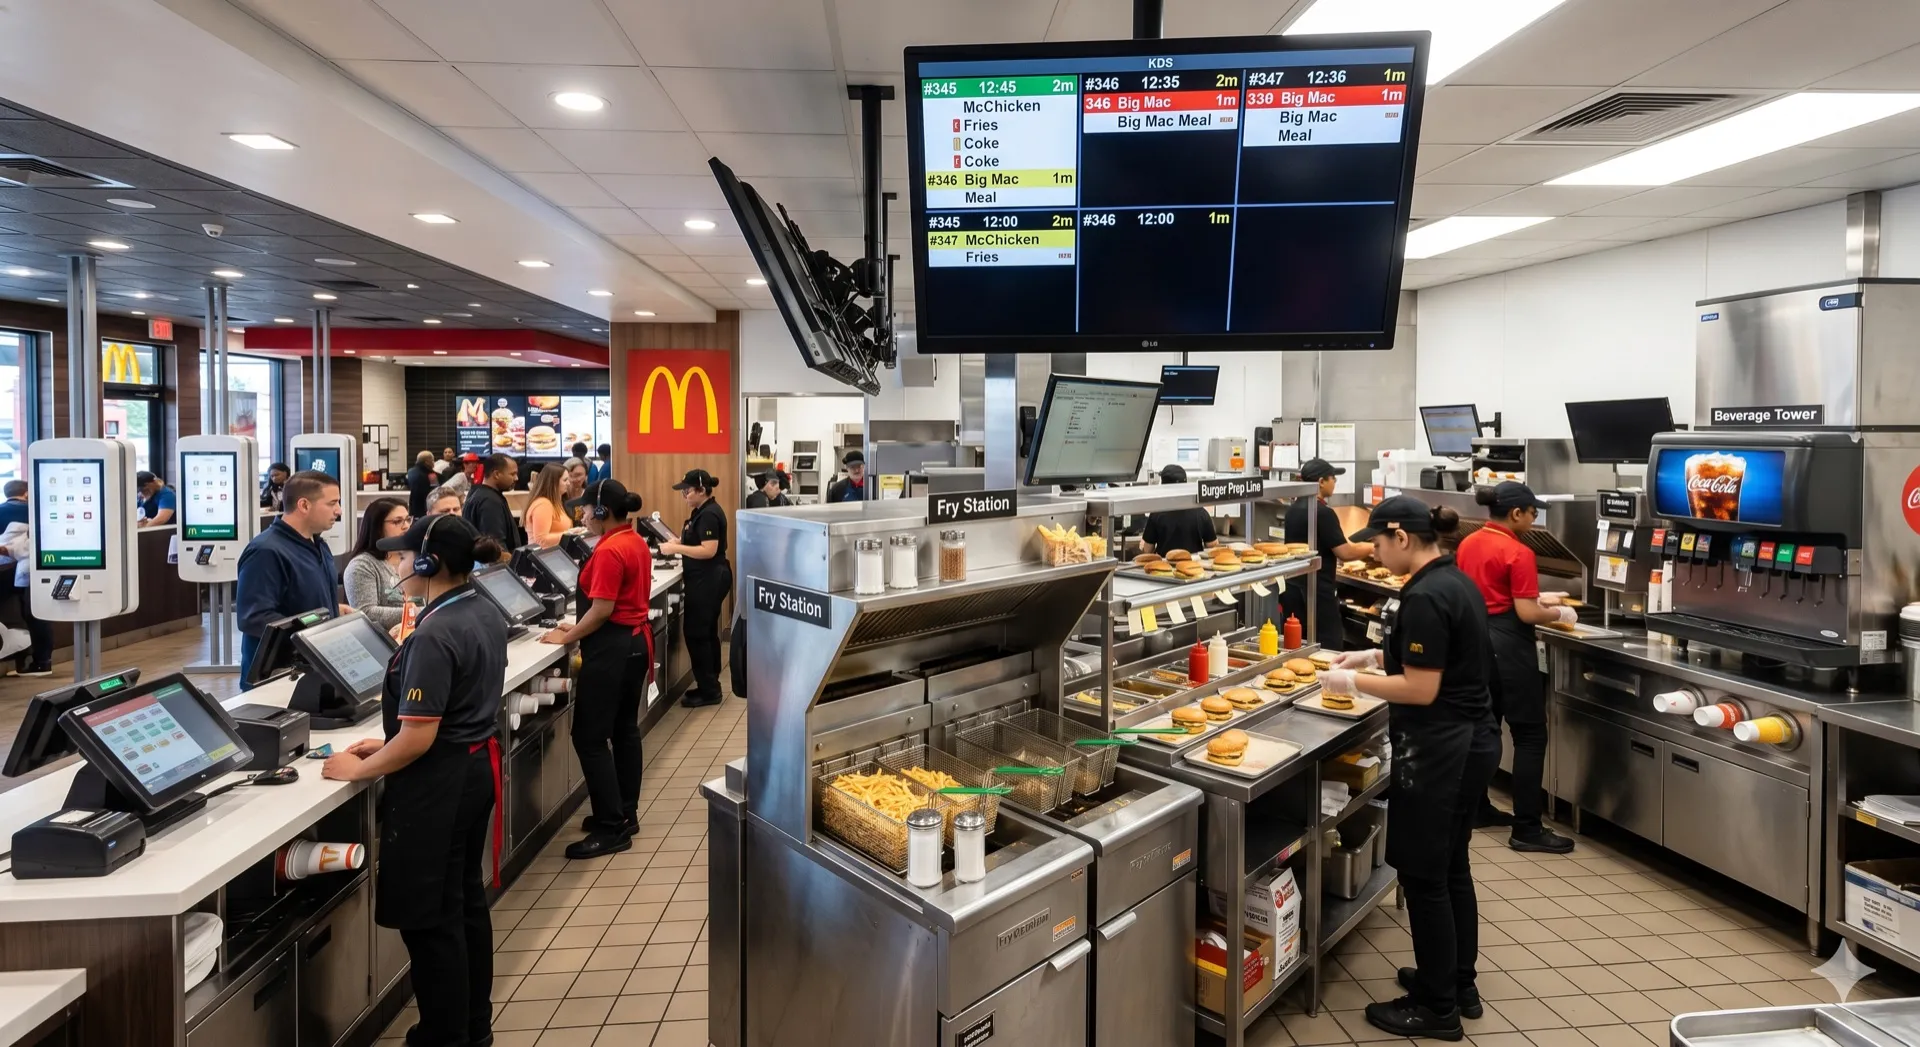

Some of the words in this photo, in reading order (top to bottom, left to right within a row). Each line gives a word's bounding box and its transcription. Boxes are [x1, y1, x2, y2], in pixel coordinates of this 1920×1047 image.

[1148, 58, 1174, 69] KDS
[1085, 77, 1119, 90] #346
[1141, 75, 1180, 89] 12:35
[1215, 74, 1238, 87] 2m
[1249, 71, 1284, 86] #347
[1307, 70, 1347, 84] 12:36
[1384, 68, 1406, 82] 1m
[923, 82, 957, 95] #345
[978, 80, 1017, 94] 12:45
[1052, 79, 1074, 92] 2m
[1085, 97, 1111, 110] 346
[1118, 97, 1140, 111] Big
[1144, 96, 1171, 108] Mac
[1216, 94, 1236, 106] 1m
[1281, 92, 1303, 107] Big
[1307, 91, 1336, 104] Mac
[1381, 88, 1403, 101] 1m
[963, 100, 1041, 113] McChicken
[964, 119, 998, 131] Fries
[1118, 115, 1141, 130] Big
[1145, 115, 1174, 127] Mac
[1179, 113, 1212, 126] Meal
[1280, 111, 1303, 126] Big
[1308, 110, 1337, 123] Mac
[964, 137, 999, 149] Coke
[1278, 128, 1312, 142] Meal
[964, 155, 999, 167] Coke
[927, 174, 958, 186] #346
[964, 173, 987, 188] Big
[991, 173, 1019, 185] Mac
[1052, 172, 1073, 184] 1m
[965, 191, 997, 203] Meal
[928, 216, 961, 228] #345
[983, 215, 1018, 228] 12:00
[1052, 214, 1073, 227] 2m
[1083, 213, 1116, 226] #346
[1137, 212, 1175, 225] 12:00
[1208, 211, 1230, 224] 1m
[929, 235, 958, 246] #347
[966, 234, 1040, 246] McChicken
[966, 251, 999, 263] Fries
[1714, 410, 1771, 424] Beverage
[1774, 408, 1817, 420] Tower
[1201, 484, 1227, 499] Burger
[1228, 482, 1245, 496] Prep
[1245, 480, 1261, 493] Line
[937, 499, 959, 518] Fry
[963, 495, 1010, 514] Station
[759, 586, 776, 610] Fry
[780, 591, 822, 618] Station
